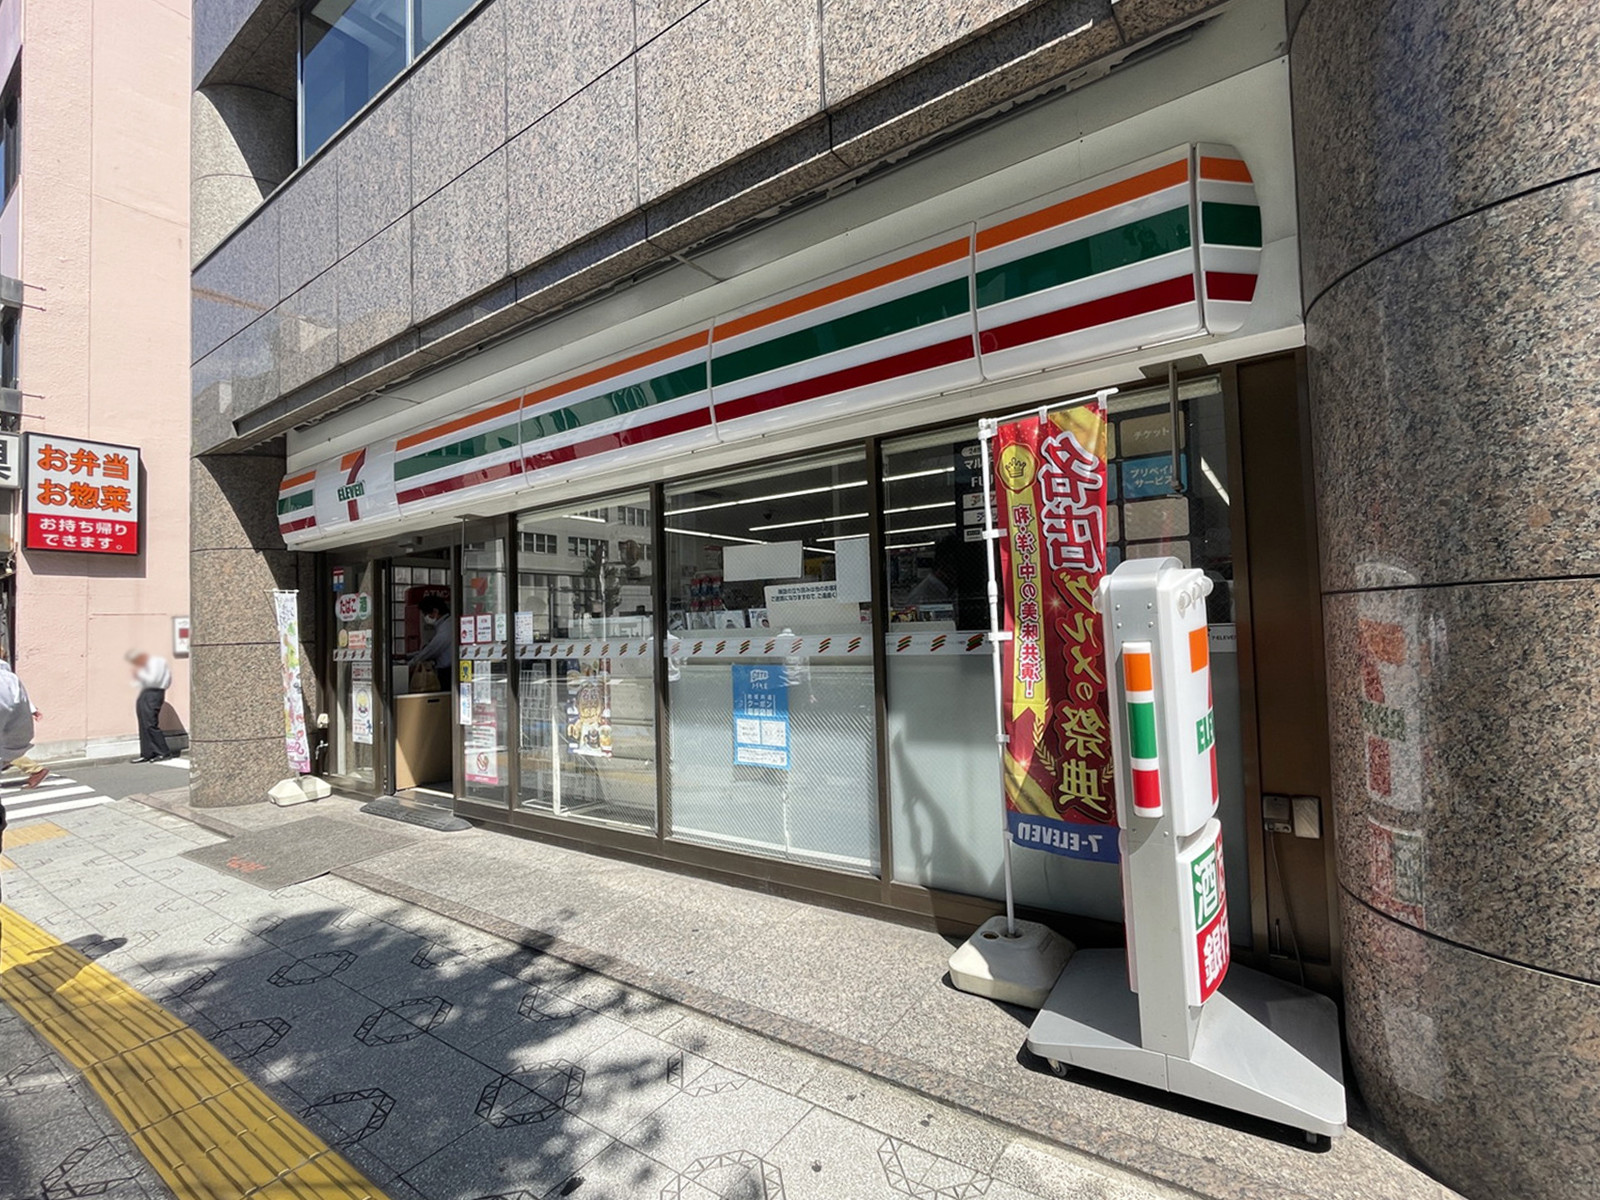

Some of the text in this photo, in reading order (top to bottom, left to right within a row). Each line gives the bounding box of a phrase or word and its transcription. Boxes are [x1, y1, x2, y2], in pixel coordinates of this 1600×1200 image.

[1134, 428, 1170, 440] チケット
[37, 443, 130, 481] お弁当
[1135, 477, 1173, 488] サービス
[37, 478, 131, 513] お惣菜
[40, 517, 128, 536] お持ち帰り
[747, 700, 773, 708] クーポン
[1194, 854, 1219, 925] 酒
